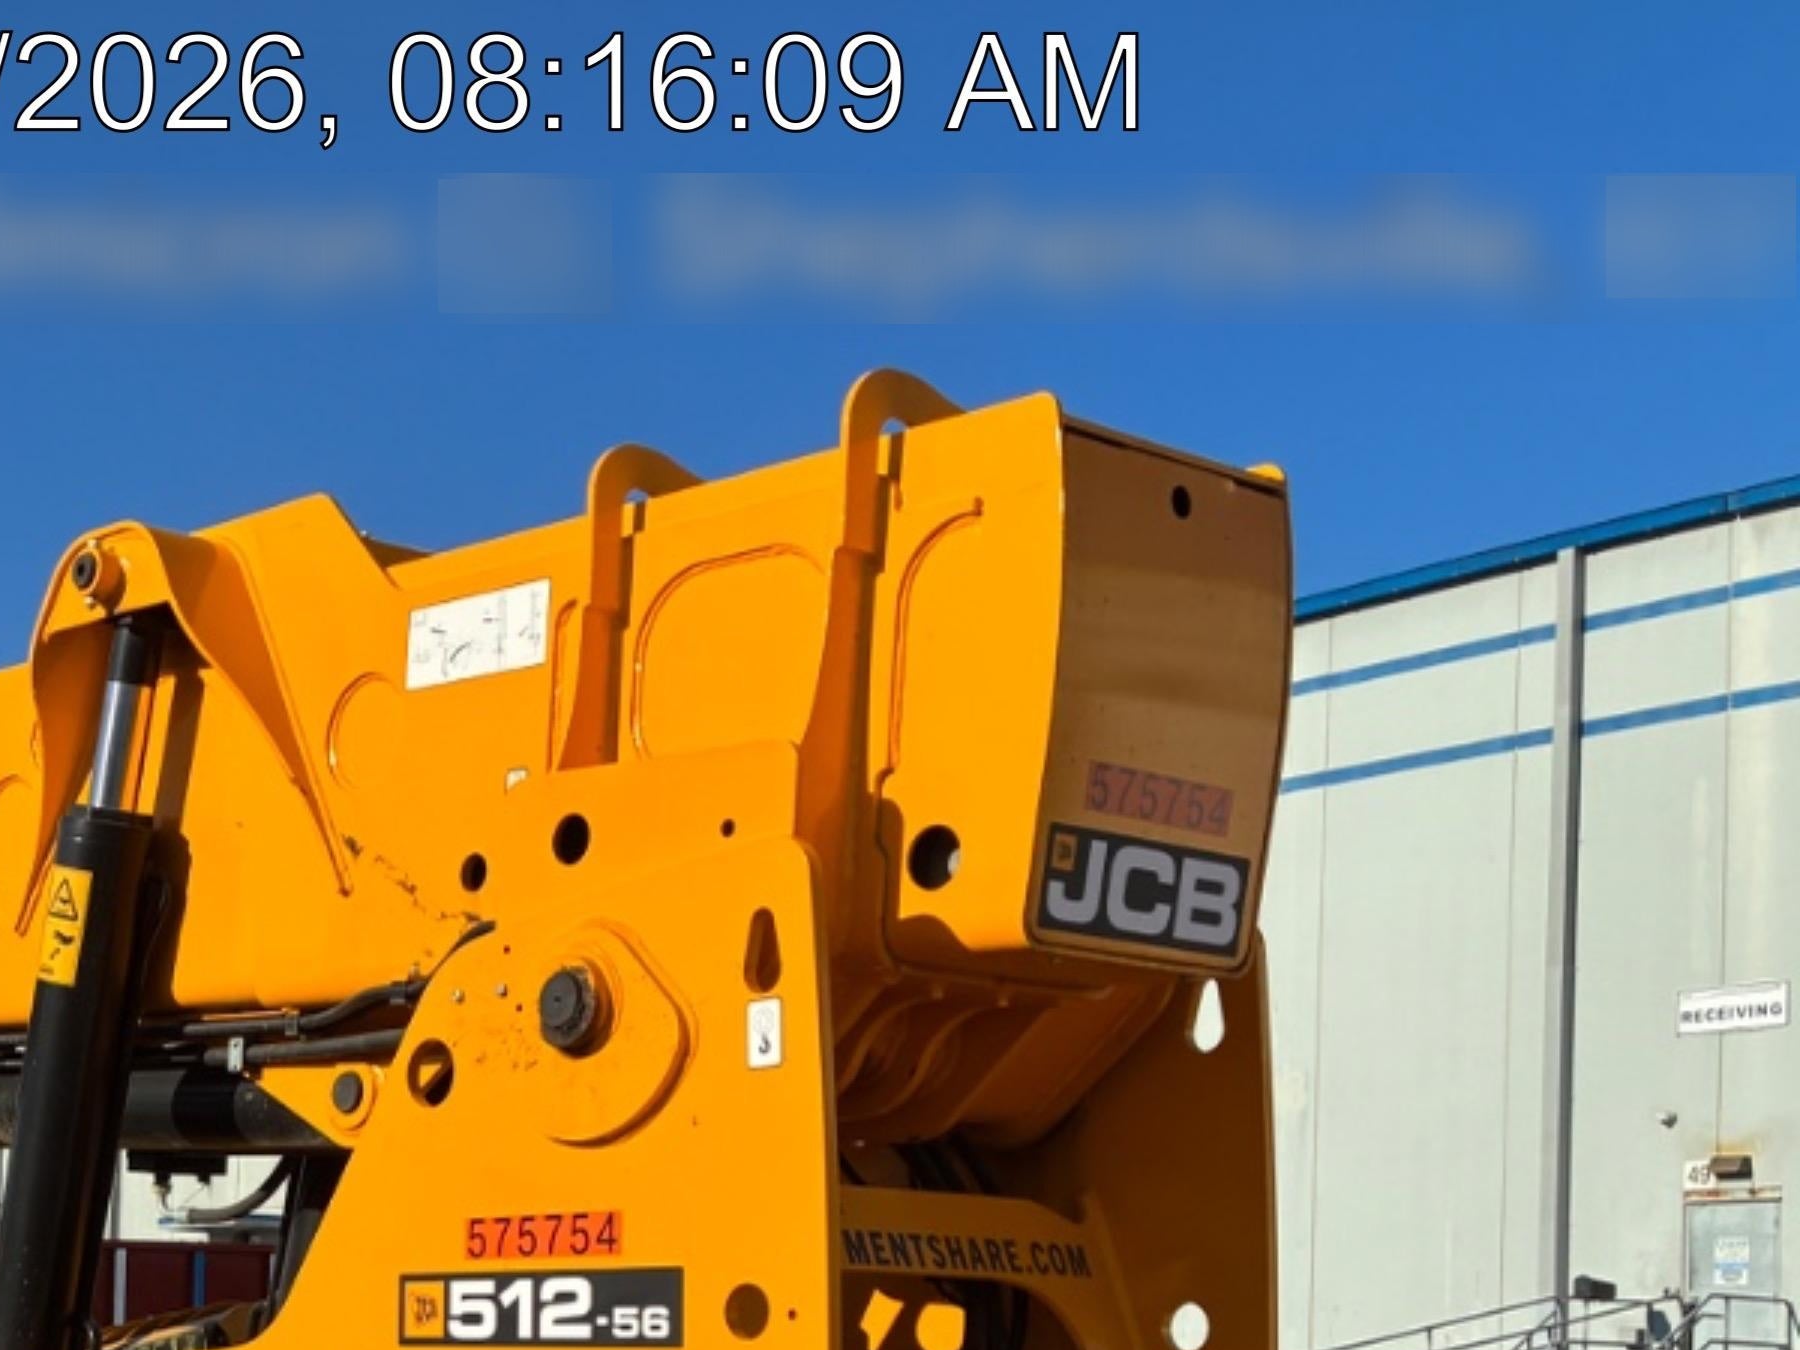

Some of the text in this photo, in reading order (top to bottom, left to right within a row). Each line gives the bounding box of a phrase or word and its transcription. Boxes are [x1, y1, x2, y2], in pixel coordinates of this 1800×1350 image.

[1089, 762, 1229, 830] 575754
[1046, 839, 1241, 946] JCB
[1681, 1002, 1783, 1024] RECEIVING
[466, 1211, 617, 1259] 575754
[842, 1229, 1093, 1277] MENTSHARE.COM
[447, 1276, 671, 1340] 512-56
